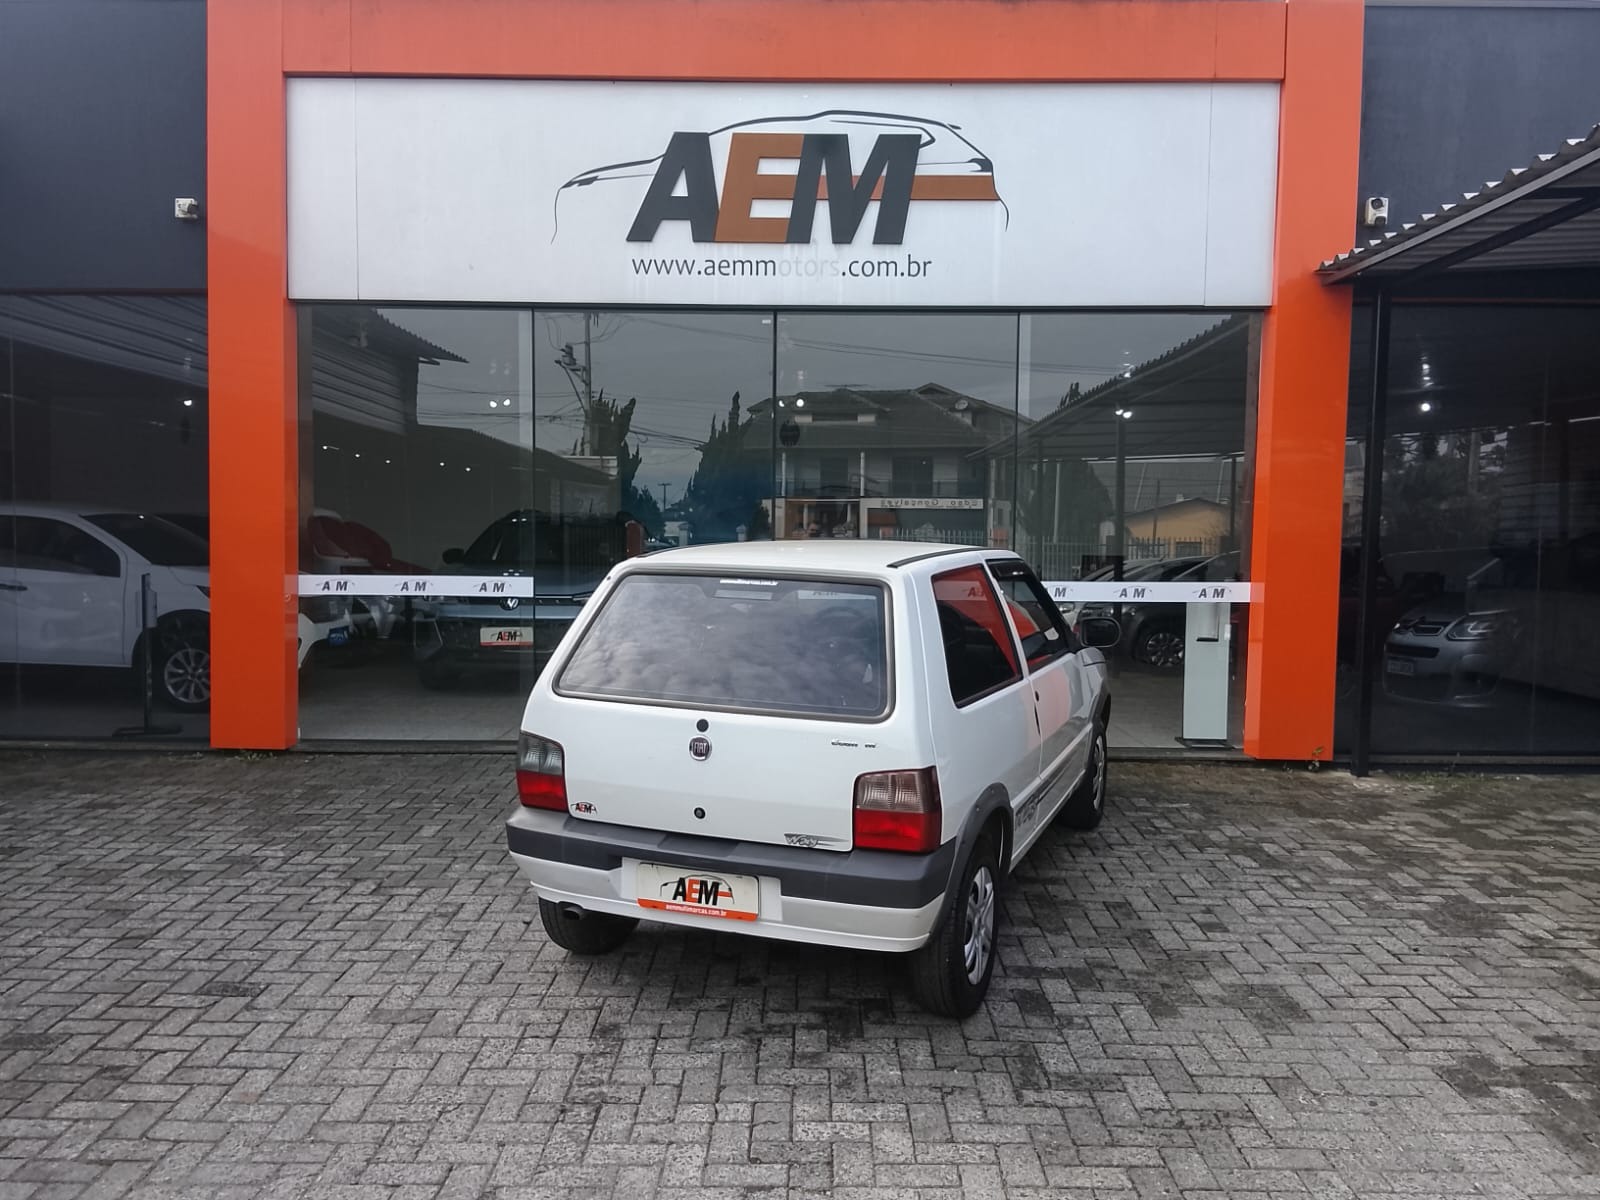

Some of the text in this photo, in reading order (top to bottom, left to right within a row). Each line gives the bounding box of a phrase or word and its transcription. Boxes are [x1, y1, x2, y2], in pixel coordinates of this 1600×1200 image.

[626, 132, 922, 245] AEM
[632, 254, 932, 278] www.aemmotors.com.br
[575, 803, 592, 814] AEM
[672, 876, 721, 906] AEM
